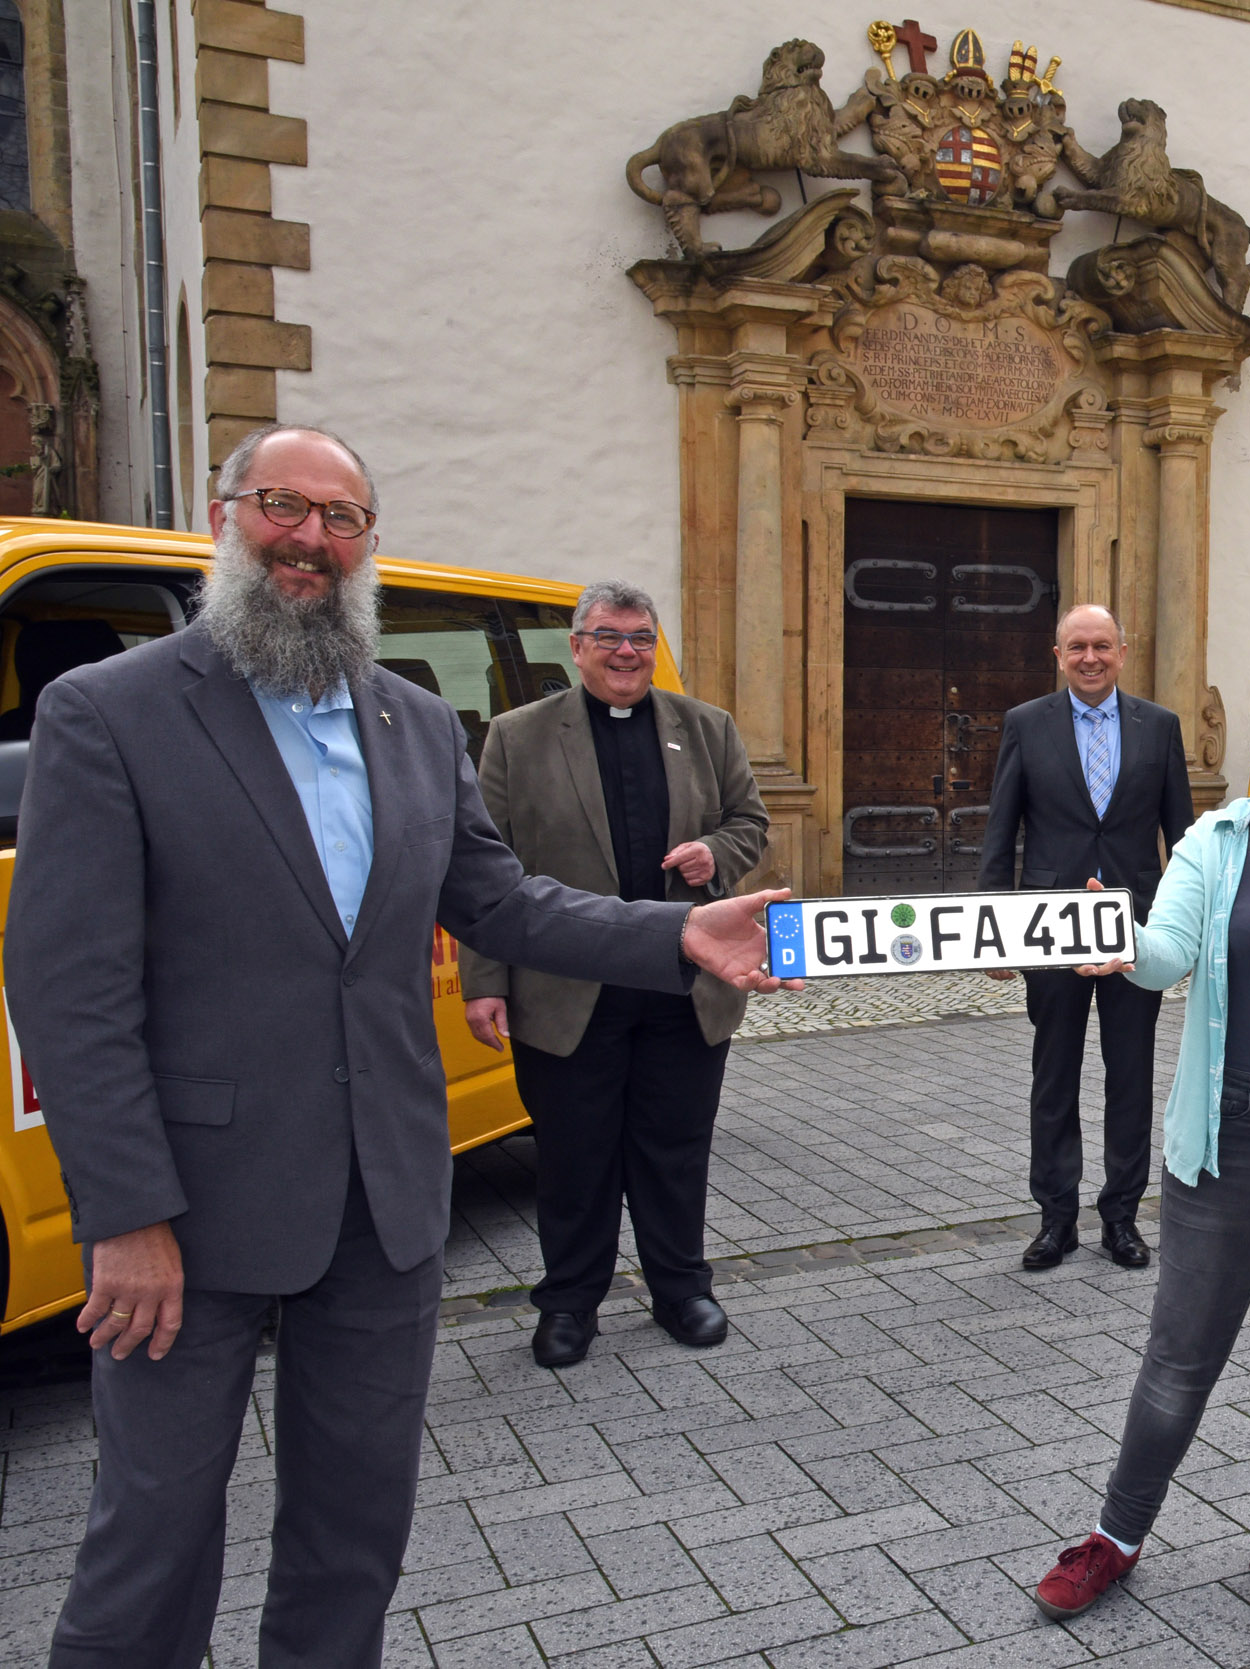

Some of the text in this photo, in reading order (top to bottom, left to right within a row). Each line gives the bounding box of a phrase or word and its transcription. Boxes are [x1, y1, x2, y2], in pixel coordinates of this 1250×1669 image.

[815, 909, 888, 966] GI
[930, 905, 1007, 961] FA
[1023, 901, 1126, 956] 410
[783, 949, 796, 965] D
